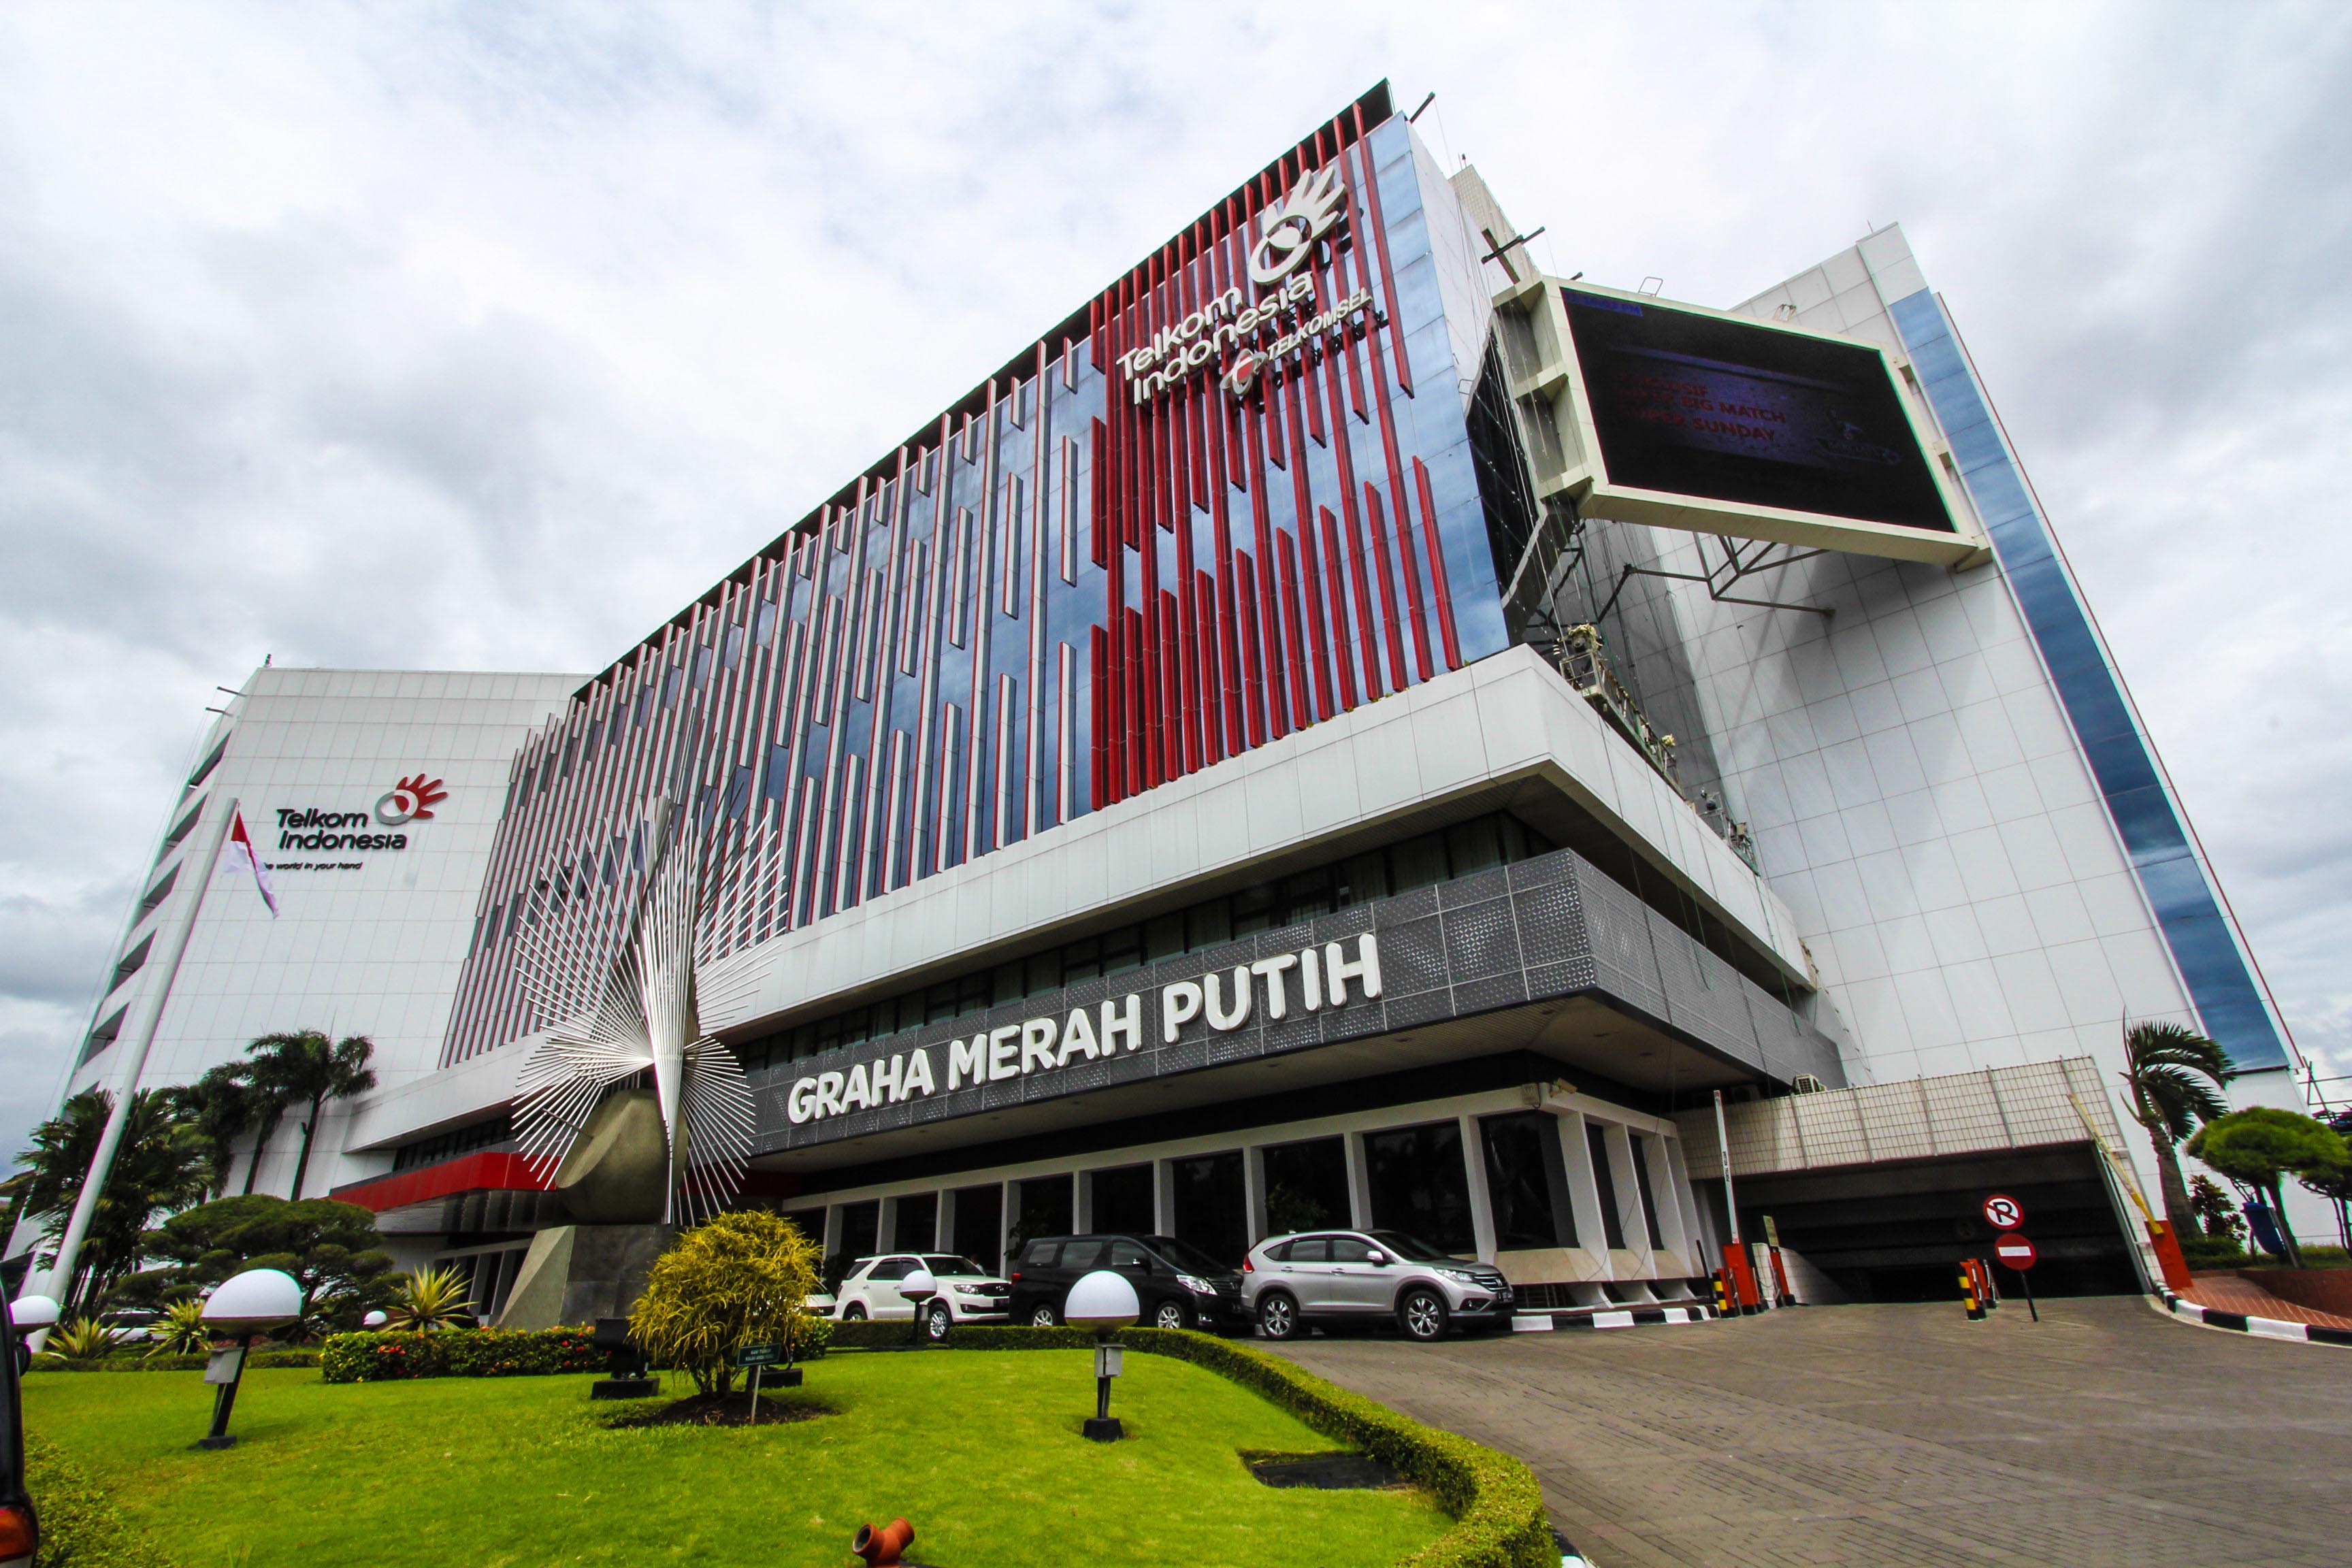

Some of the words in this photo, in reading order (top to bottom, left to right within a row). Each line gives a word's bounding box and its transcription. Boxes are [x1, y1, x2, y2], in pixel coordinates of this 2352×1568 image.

[1116, 286, 1243, 381] Telkom
[1267, 287, 1373, 361] TELKOMSEL
[1134, 271, 1315, 405] Indonesia
[1718, 401, 1786, 424] MATCH
[1692, 417, 1776, 442] SUNDAY
[276, 808, 369, 828] Telkom
[278, 830, 408, 849] Indonesia
[276, 862, 304, 870] world
[314, 862, 337, 871] your
[338, 862, 363, 870] hand
[787, 1049, 935, 1124] GRAHA
[949, 994, 1142, 1090] MERAH
[1162, 932, 1382, 1045] PUTIH
